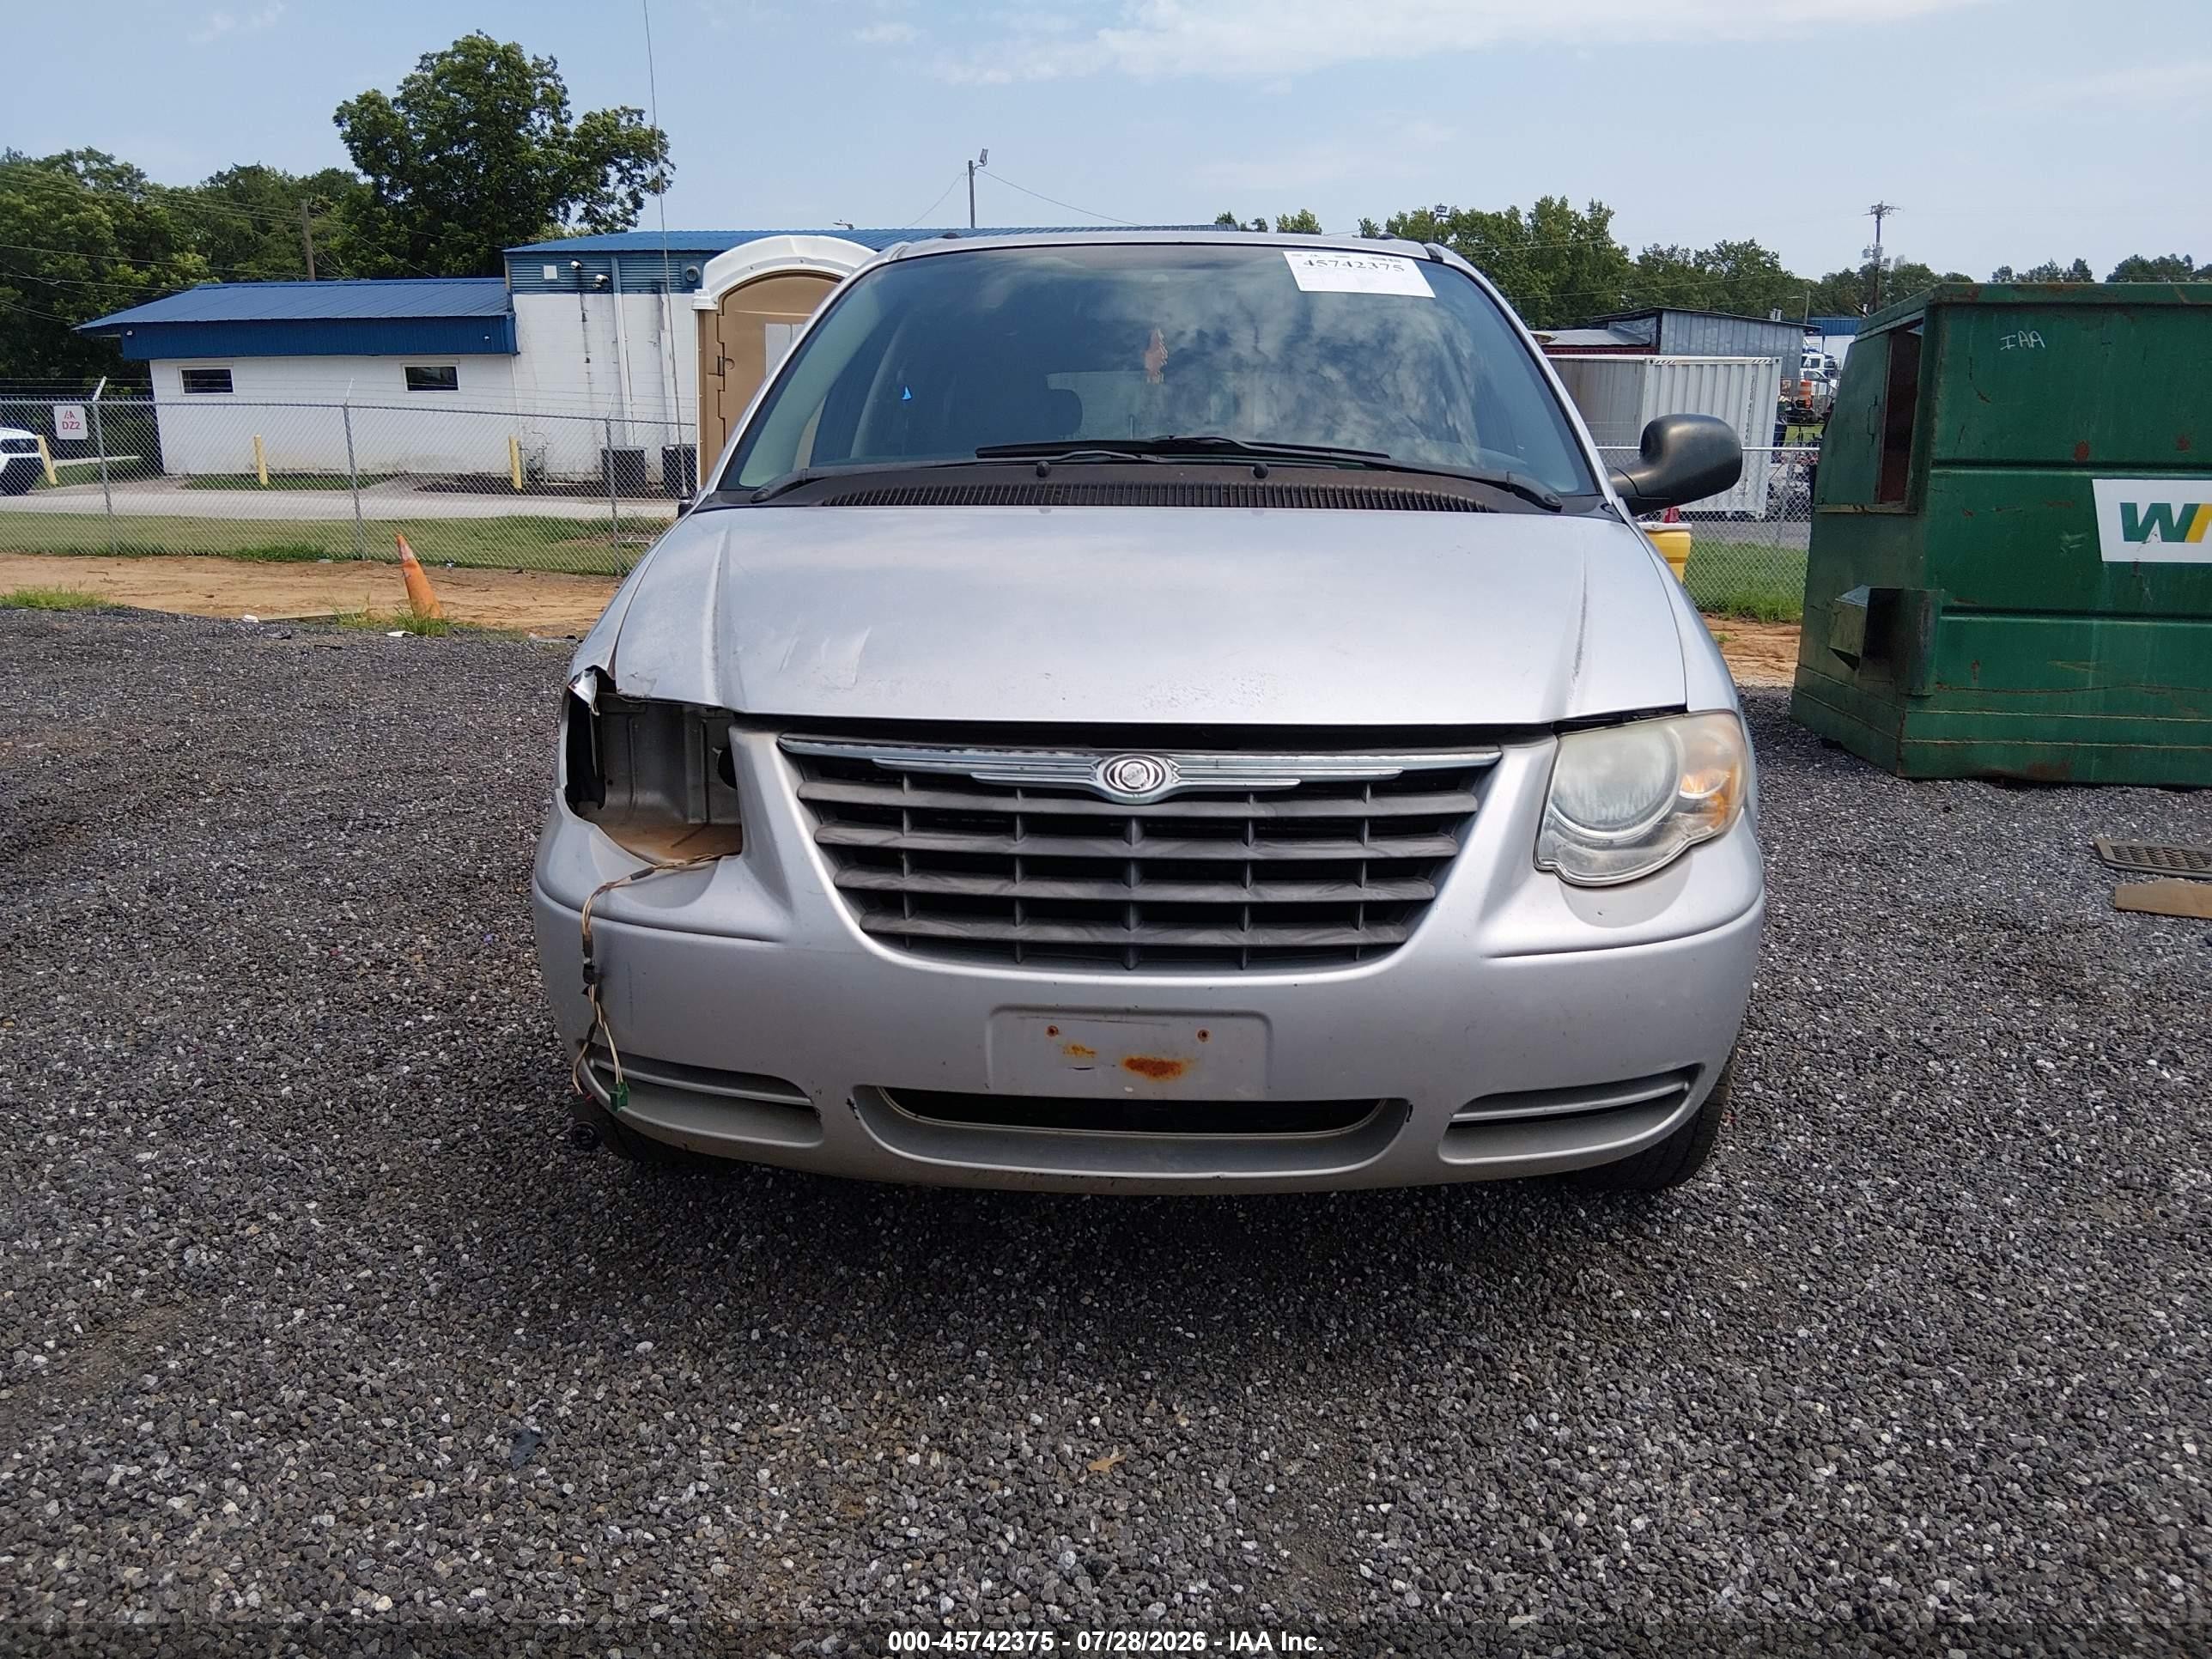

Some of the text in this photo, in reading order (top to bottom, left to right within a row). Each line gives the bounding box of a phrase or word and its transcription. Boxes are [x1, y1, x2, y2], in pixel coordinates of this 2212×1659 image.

[1304, 259, 1405, 271] 45742375
[2000, 330, 2045, 350] IAA
[62, 421, 82, 430] DZ2
